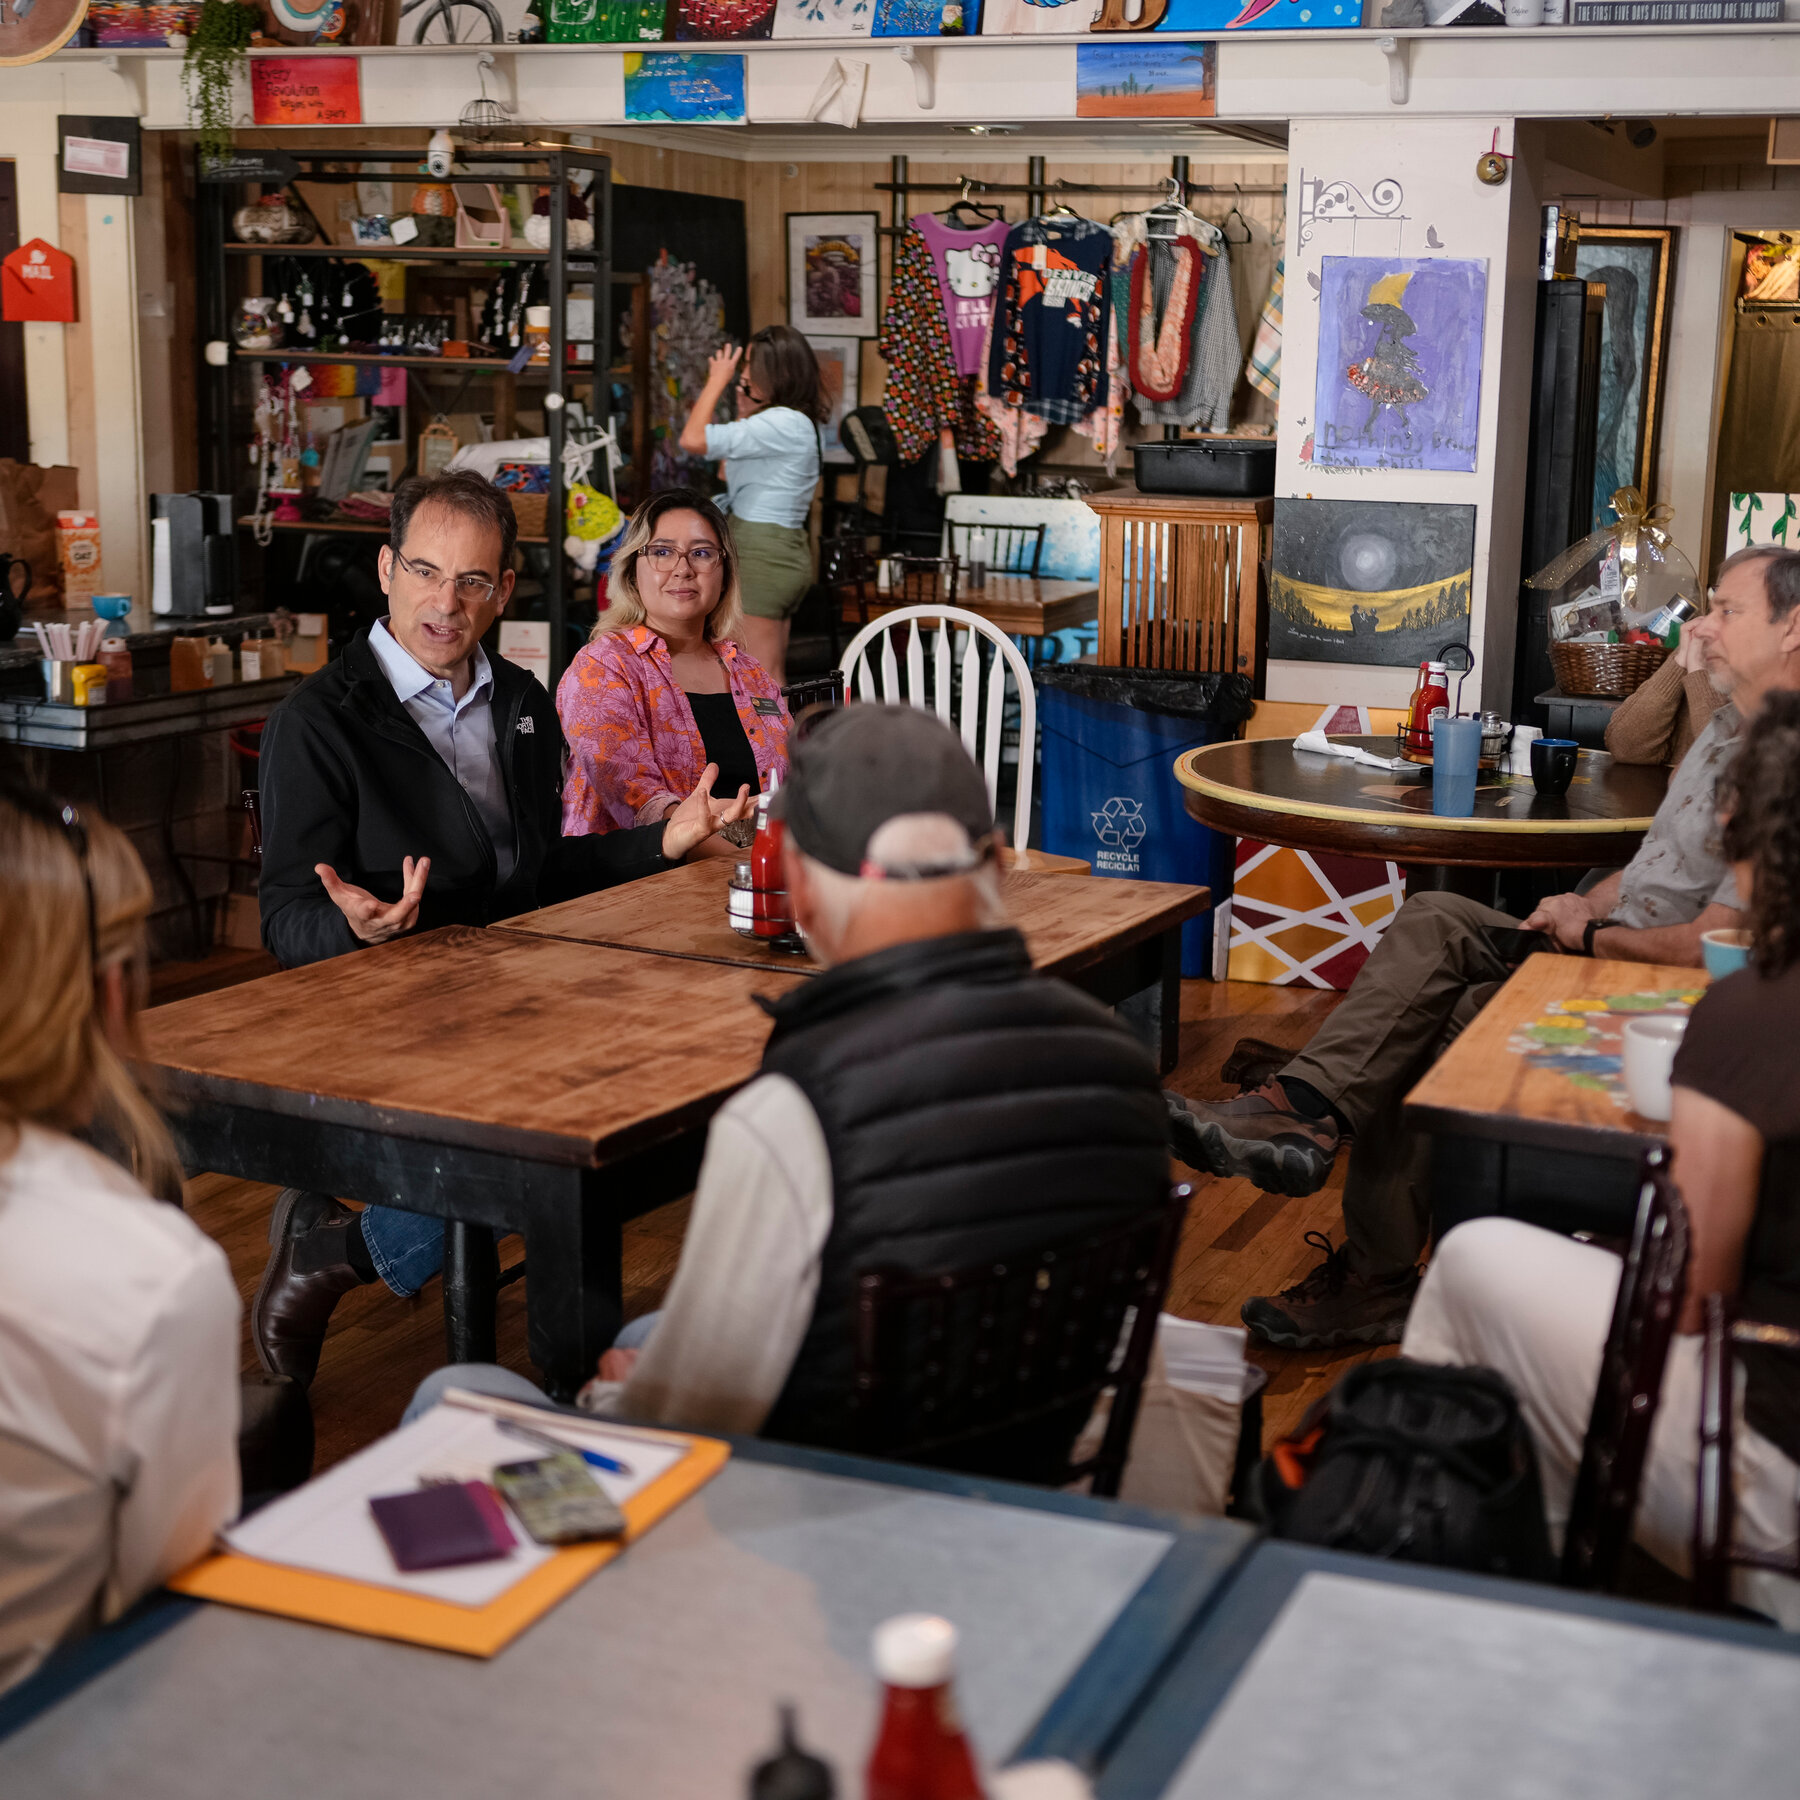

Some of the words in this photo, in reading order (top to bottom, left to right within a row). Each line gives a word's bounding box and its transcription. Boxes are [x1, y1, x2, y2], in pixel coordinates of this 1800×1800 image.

[1578, 5, 1590, 21] THE
[1592, 5, 1612, 21] FIRST
[1614, 5, 1630, 20] FIVE
[1632, 4, 1649, 20] DAYS
[1651, 4, 1673, 20] AFTER
[1675, 4, 1688, 20] THE
[1690, 3, 1722, 19] WEEKEND
[1723, 3, 1738, 18] ARE
[1740, 3, 1753, 18] THE
[1755, 2, 1780, 18] WORST
[265, 82, 320, 97] Revolution
[1043, 268, 1098, 285] DENVER
[1096, 850, 1140, 862] RECYCLE
[1096, 861, 1140, 872] RECICLAR
